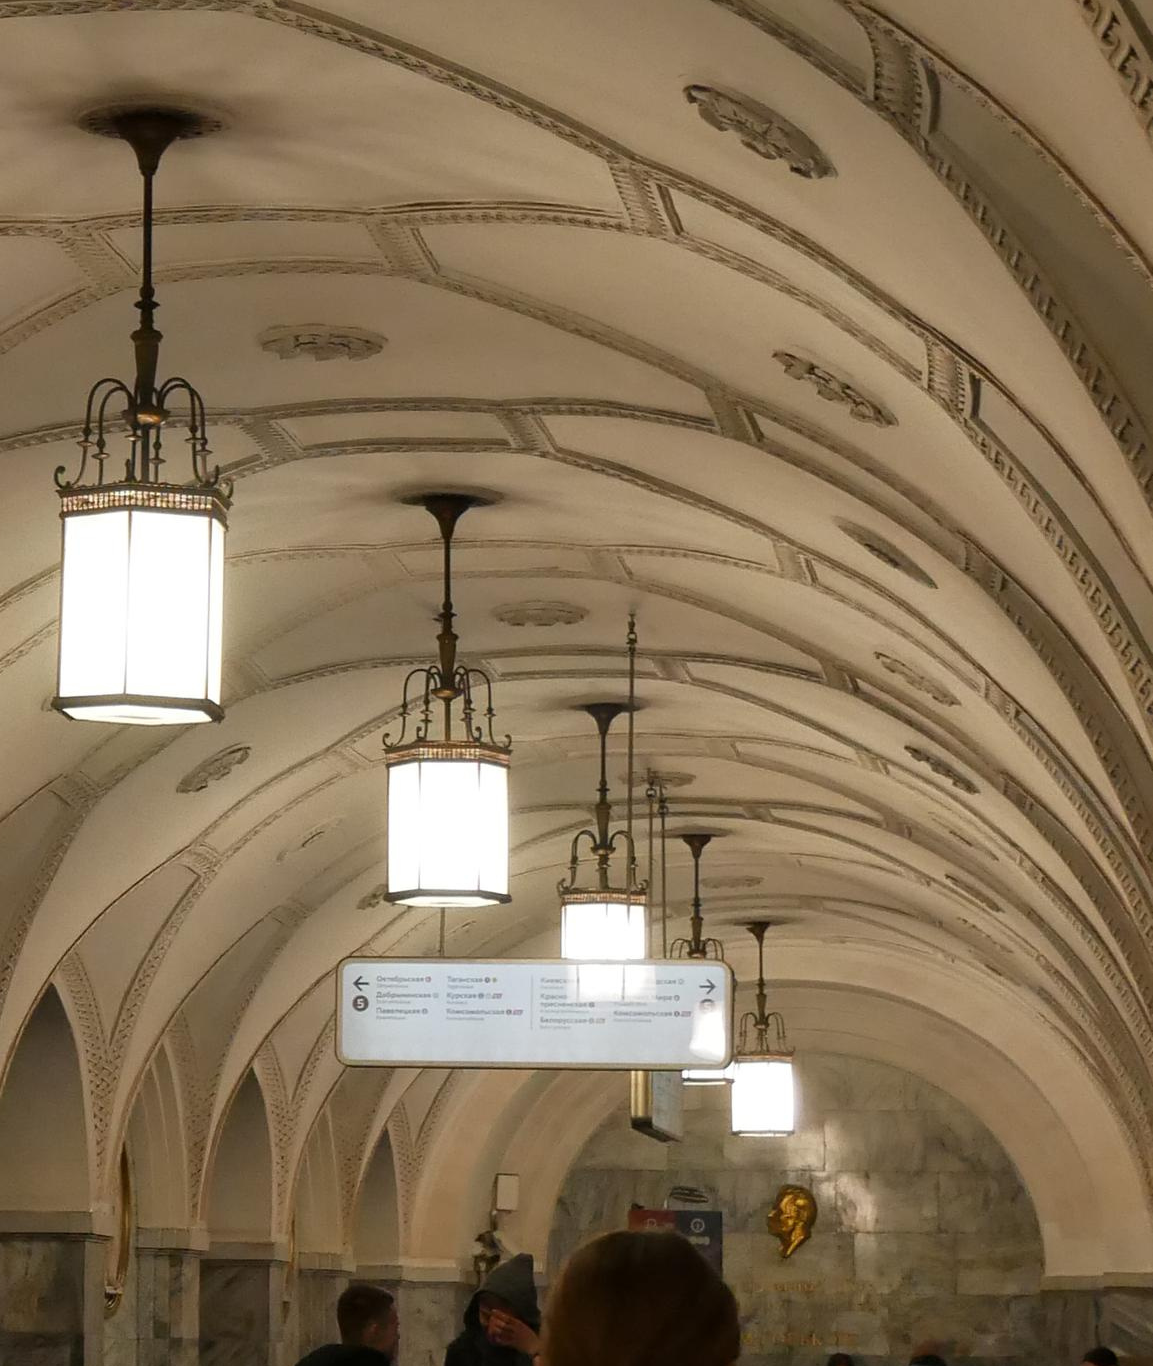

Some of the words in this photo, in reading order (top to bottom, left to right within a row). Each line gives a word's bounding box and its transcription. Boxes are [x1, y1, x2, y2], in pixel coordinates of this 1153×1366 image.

[376, 975, 424, 983] Октябрьская
[446, 992, 477, 1000] Курская
[376, 1007, 421, 1015] Павелецкая
